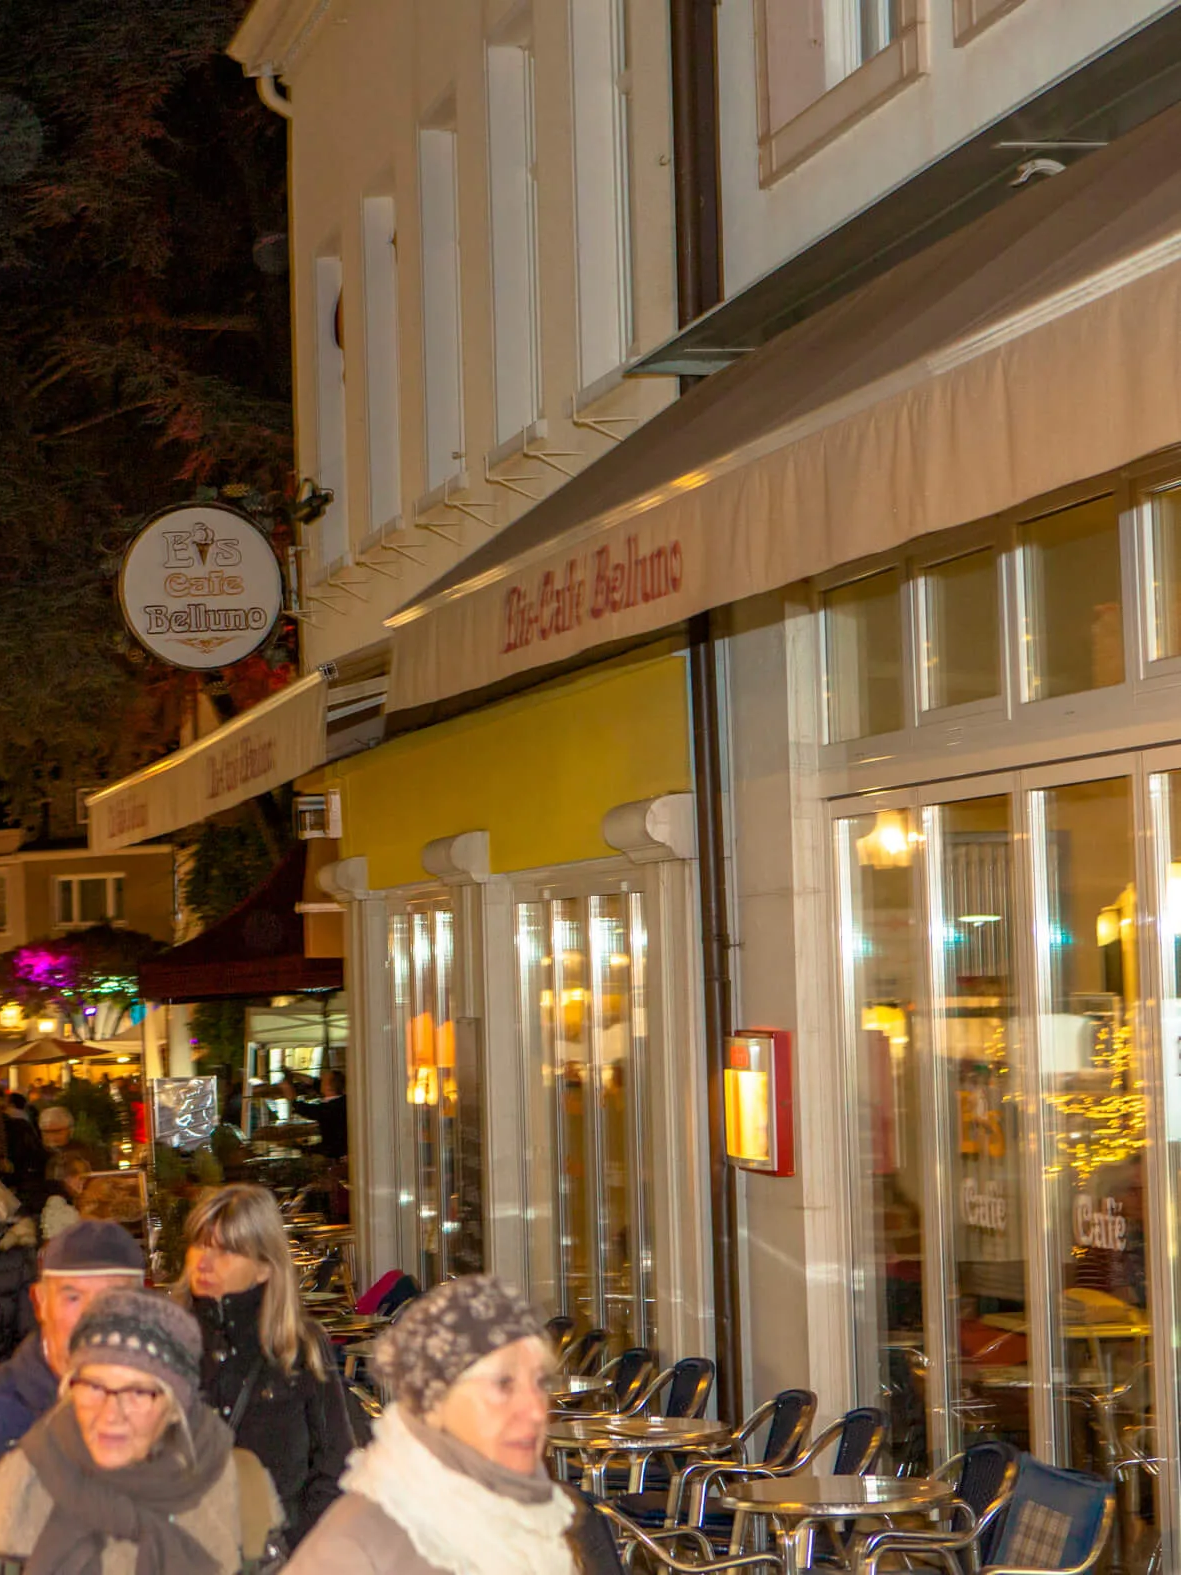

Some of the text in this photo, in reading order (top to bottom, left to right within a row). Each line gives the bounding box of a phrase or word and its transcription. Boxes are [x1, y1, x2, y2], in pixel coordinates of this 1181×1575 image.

[164, 570, 245, 598] Cafe
[589, 534, 683, 619] Belluno
[143, 603, 268, 634] Belluno
